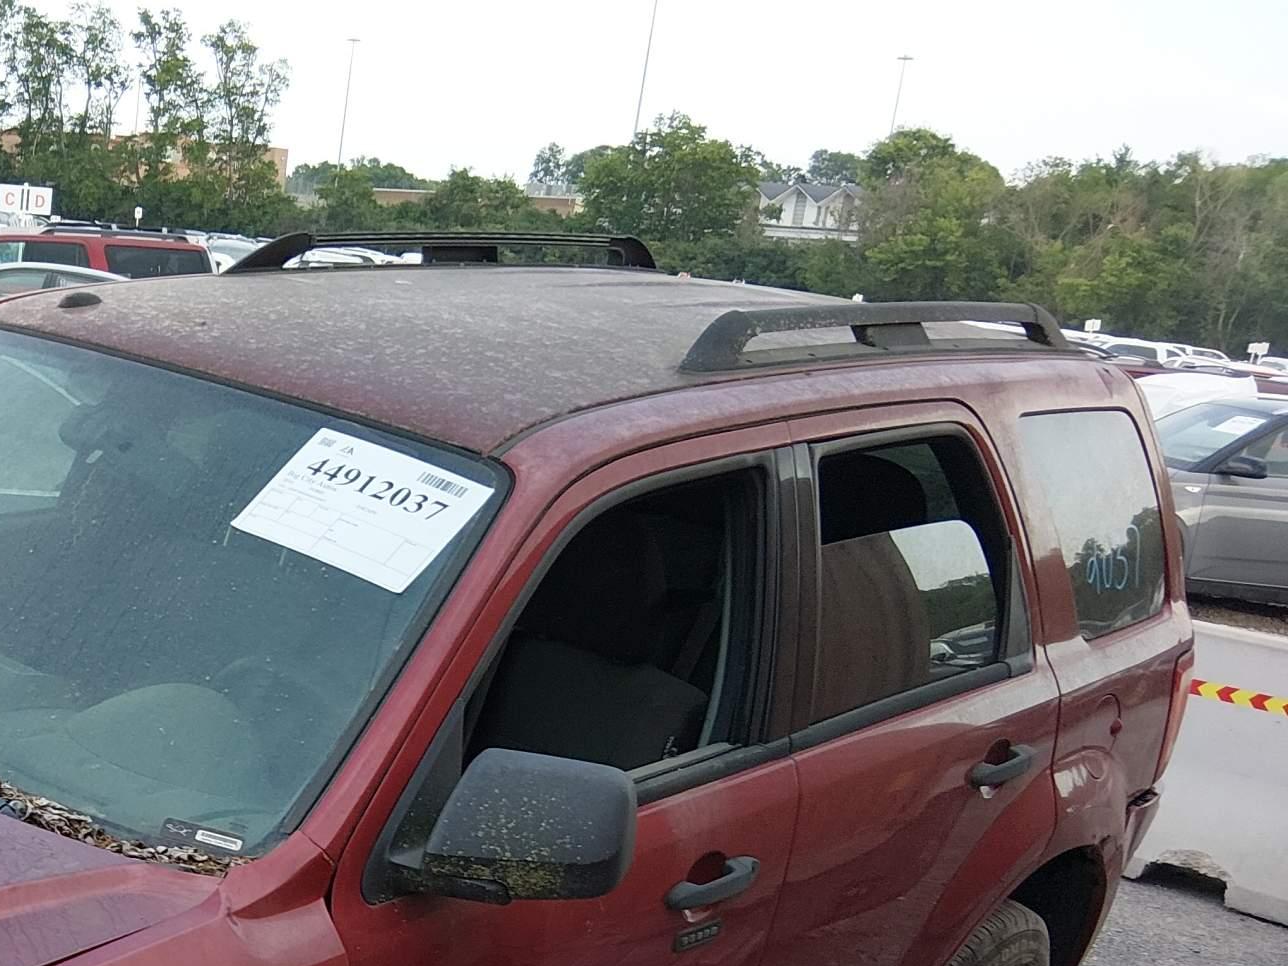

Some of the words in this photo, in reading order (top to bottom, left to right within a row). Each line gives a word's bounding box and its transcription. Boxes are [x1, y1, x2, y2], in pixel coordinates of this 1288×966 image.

[5, 192, 15, 206] C
[35, 194, 45, 208] D
[306, 458, 449, 520] 44912037
